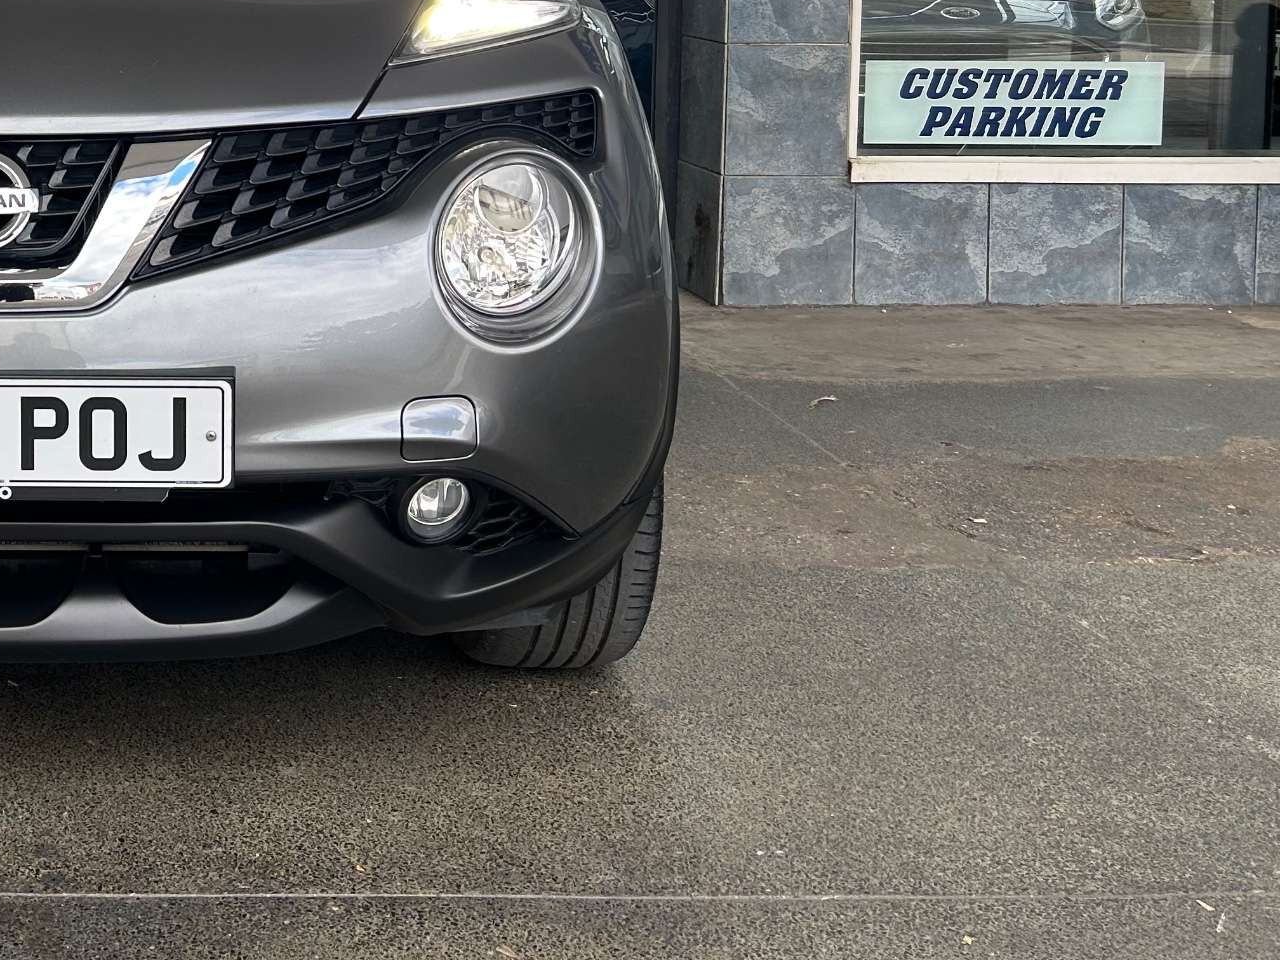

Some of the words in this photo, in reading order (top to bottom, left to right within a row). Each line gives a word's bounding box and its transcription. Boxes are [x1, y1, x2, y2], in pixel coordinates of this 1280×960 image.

[899, 67, 1129, 101] CUSTOMER
[918, 105, 1106, 139] PARKING
[20, 396, 188, 472] POJ
